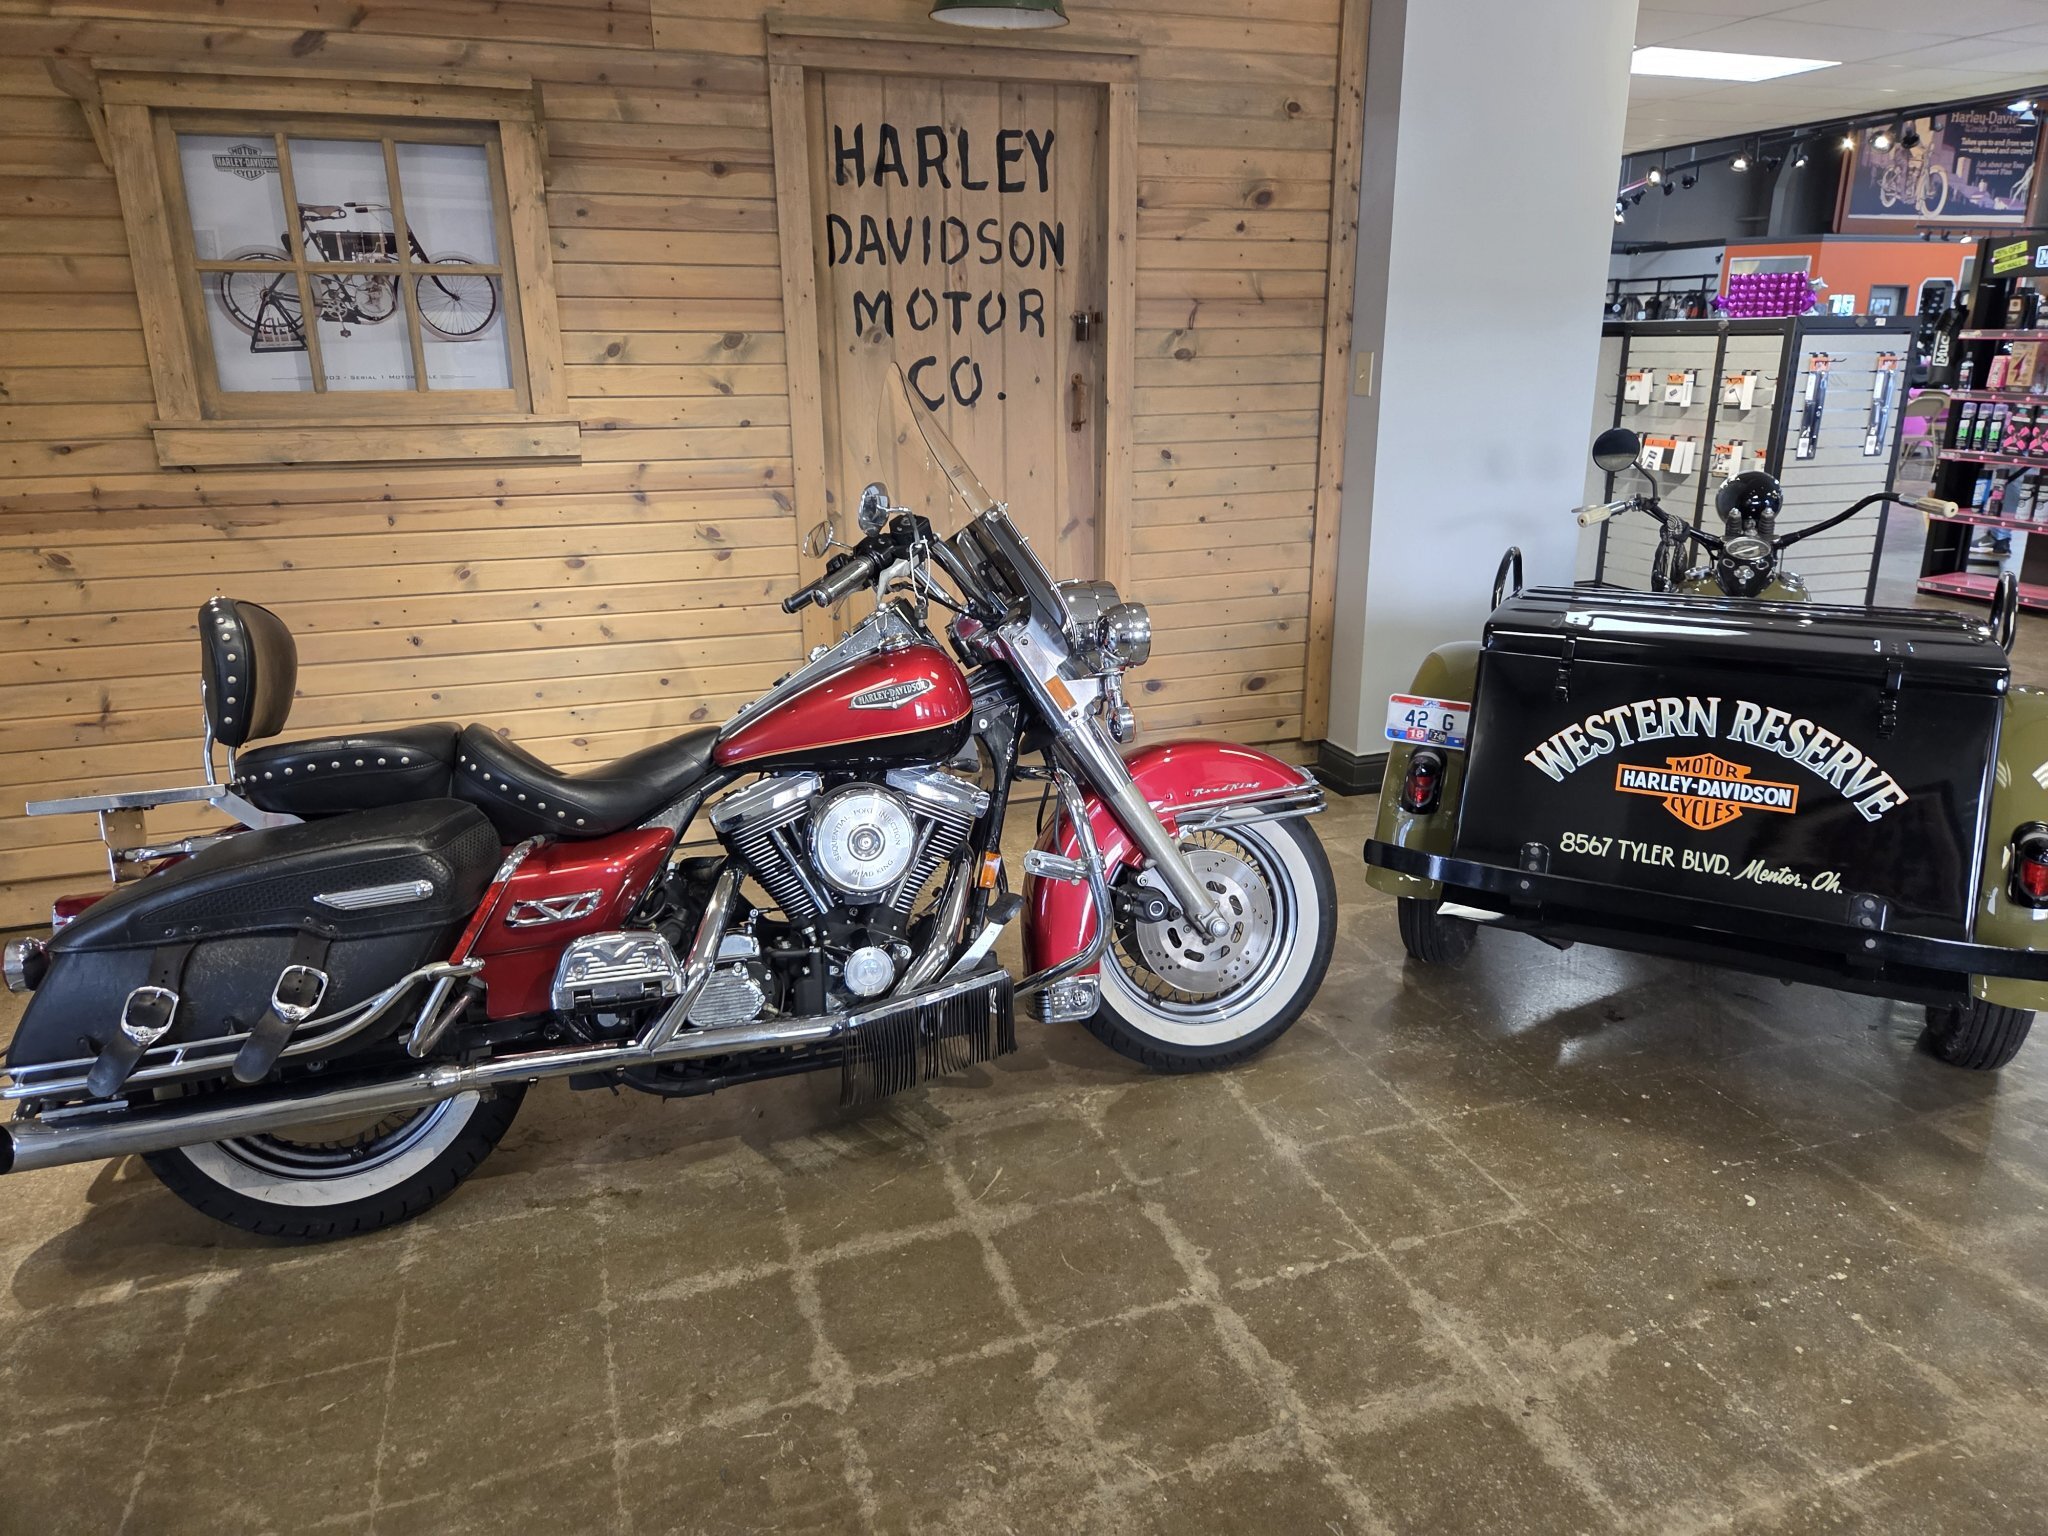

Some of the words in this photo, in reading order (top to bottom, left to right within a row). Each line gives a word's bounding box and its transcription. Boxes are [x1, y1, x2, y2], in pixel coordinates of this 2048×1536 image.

[231, 146, 258, 155] MOTOR
[834, 123, 1055, 193] HARLEY
[2010, 147, 2033, 156] comfort
[236, 169, 262, 179] CYCLES
[826, 213, 1065, 270] DAVIDSON
[853, 286, 1045, 338] MOTOR
[907, 355, 1007, 412] CO.
[1405, 709, 1429, 728] 42
[1442, 713, 1455, 731] G
[1409, 729, 1425, 738] 18
[1523, 696, 1721, 783] WESTERN
[1727, 699, 1910, 823] RESERVE
[1675, 755, 1738, 778] MOTOR
[1622, 769, 1792, 808] HARLEY-DAVIDSON
[1670, 796, 1736, 826] CYCLES
[831, 816, 850, 862] SEQUENTIAL
[878, 809, 901, 846] INJECTION
[851, 869, 874, 878] ROAD
[876, 859, 894, 874] KING
[1560, 831, 1613, 858] 8567
[1617, 838, 1675, 869] TYLER
[1681, 849, 1731, 876] BLVD.
[1811, 870, 1843, 894] Oh.
